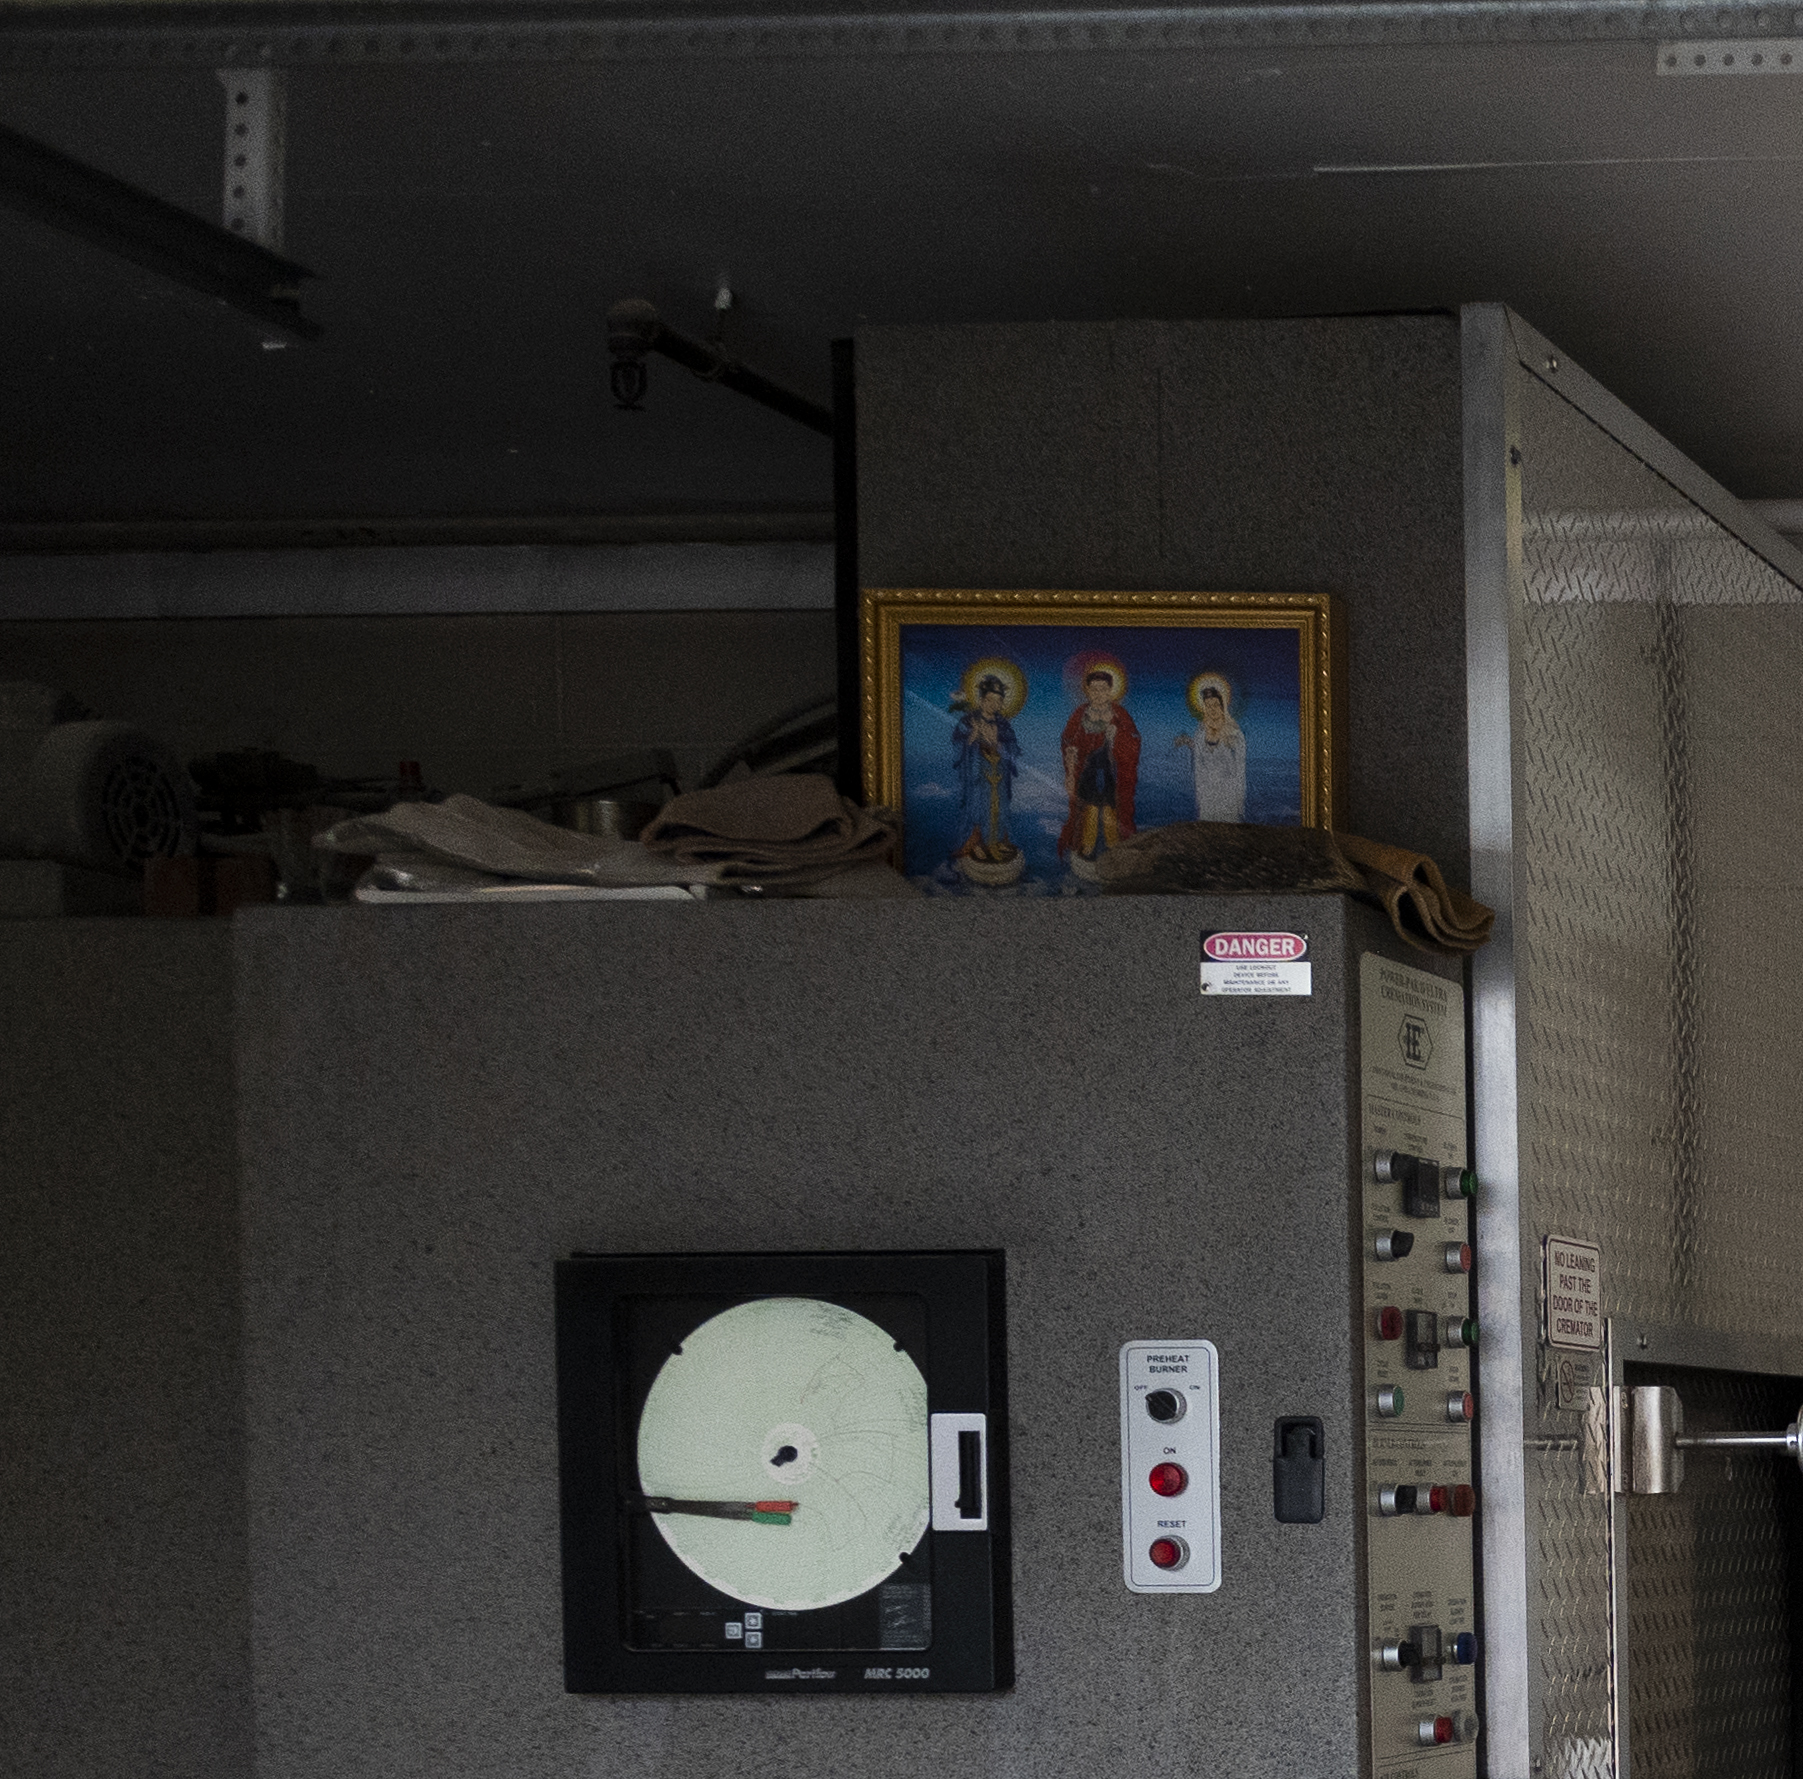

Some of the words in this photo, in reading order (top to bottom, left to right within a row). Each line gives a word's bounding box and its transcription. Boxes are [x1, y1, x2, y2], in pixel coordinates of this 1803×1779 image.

[1214, 938, 1295, 956] DANGER
[1555, 1250, 1565, 1267] NO
[1566, 1253, 1595, 1273] LEANING
[1560, 1274, 1576, 1291] PAST
[1578, 1277, 1591, 1294] THE
[1553, 1295, 1573, 1312] DOOR
[1574, 1298, 1583, 1314] OF
[1585, 1300, 1598, 1317] THE
[1556, 1318, 1593, 1337] CREMATOR
[1147, 1354, 1190, 1363] PREHEAT
[1149, 1365, 1188, 1373] BURNER
[1157, 1520, 1186, 1528] RESET
[864, 1667, 893, 1680] MRC
[895, 1667, 930, 1679] 5000
